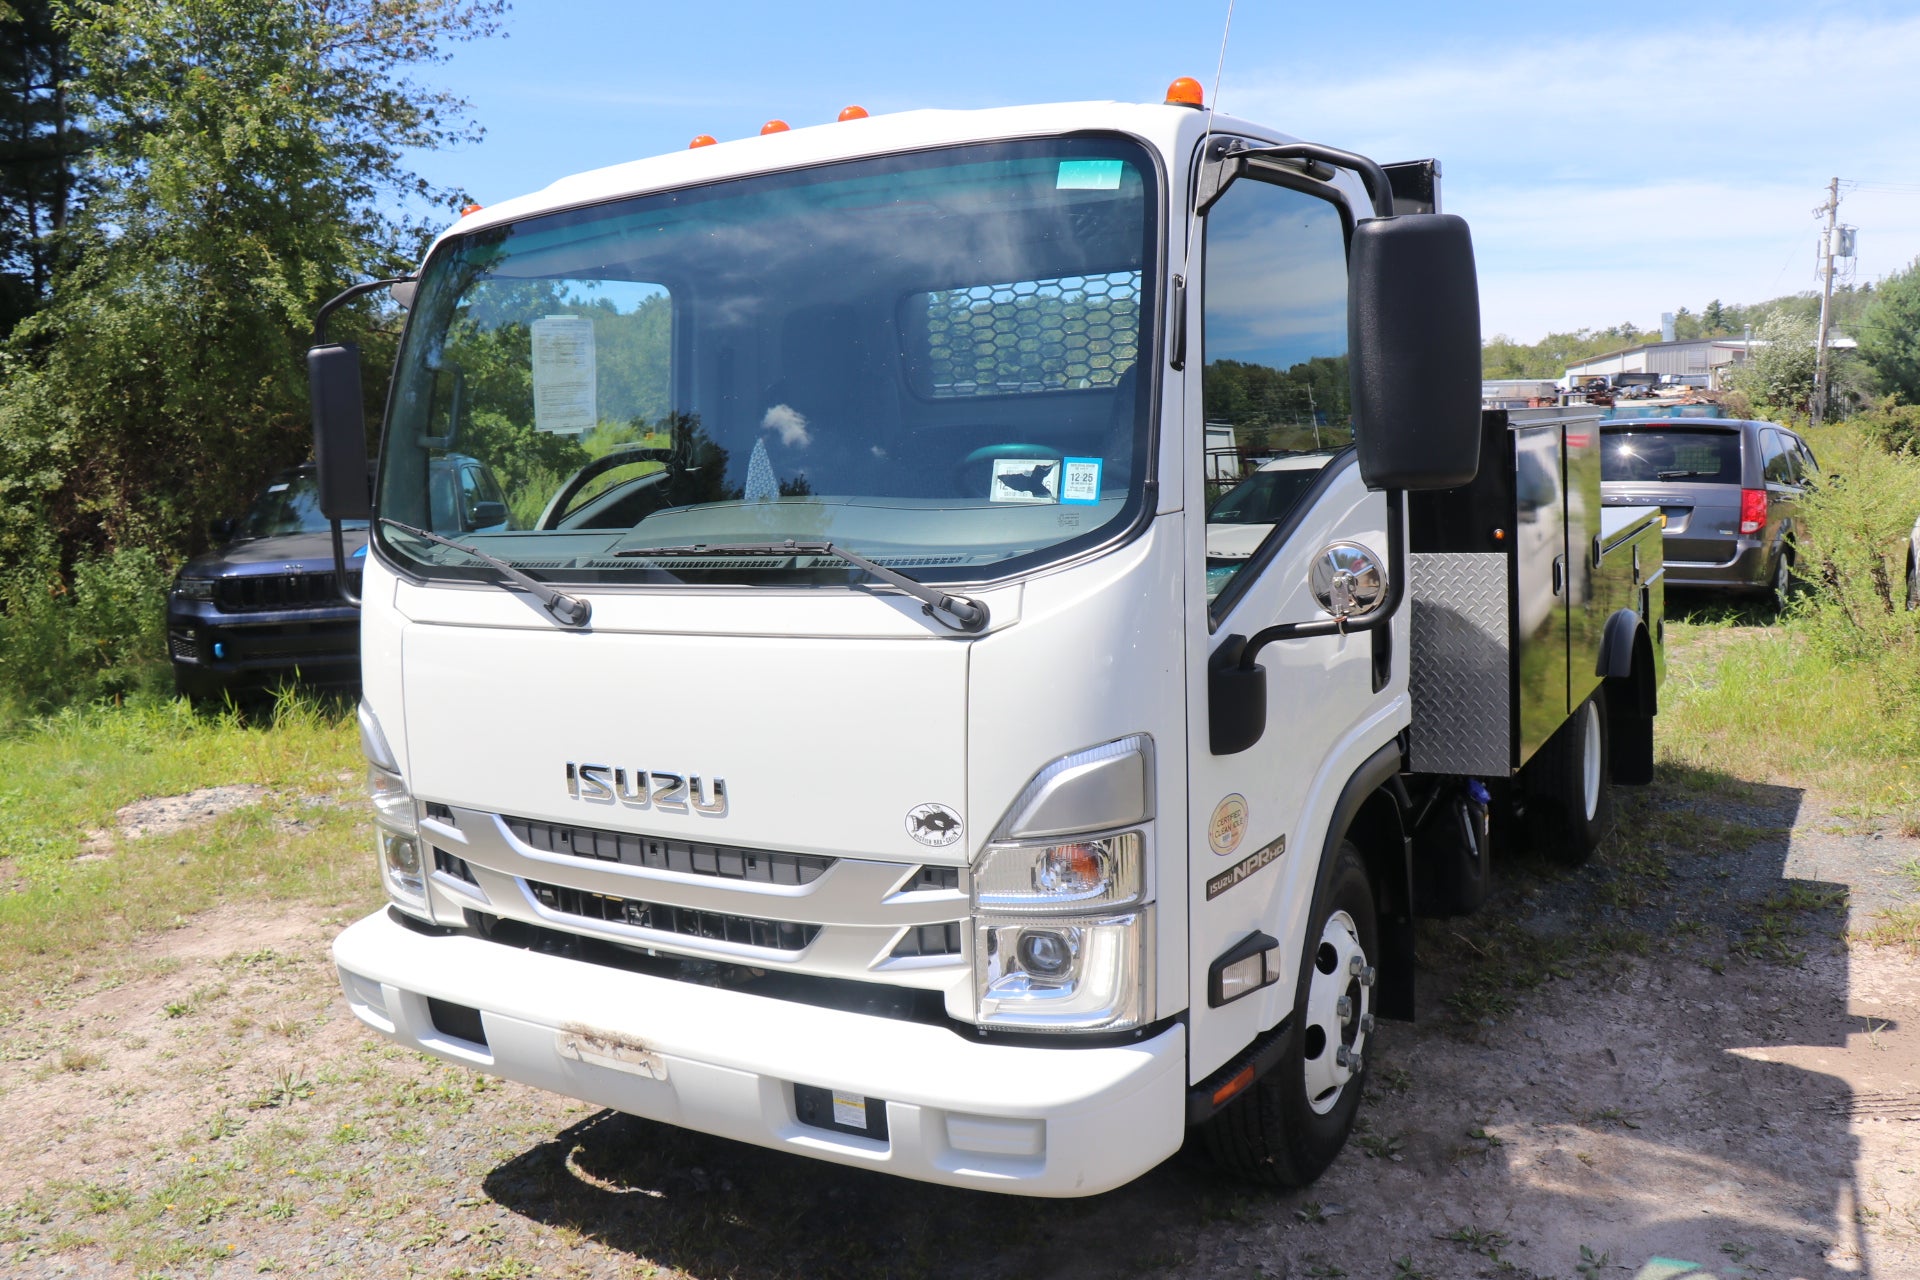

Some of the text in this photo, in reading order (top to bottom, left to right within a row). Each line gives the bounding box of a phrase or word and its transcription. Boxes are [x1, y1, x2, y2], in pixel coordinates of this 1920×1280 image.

[566, 760, 727, 814] ISUZU
[1215, 825, 1232, 838] CLEAN
[1217, 809, 1241, 827] CERTIFIED
[1210, 844, 1284, 894] ISUZU NPR HD
